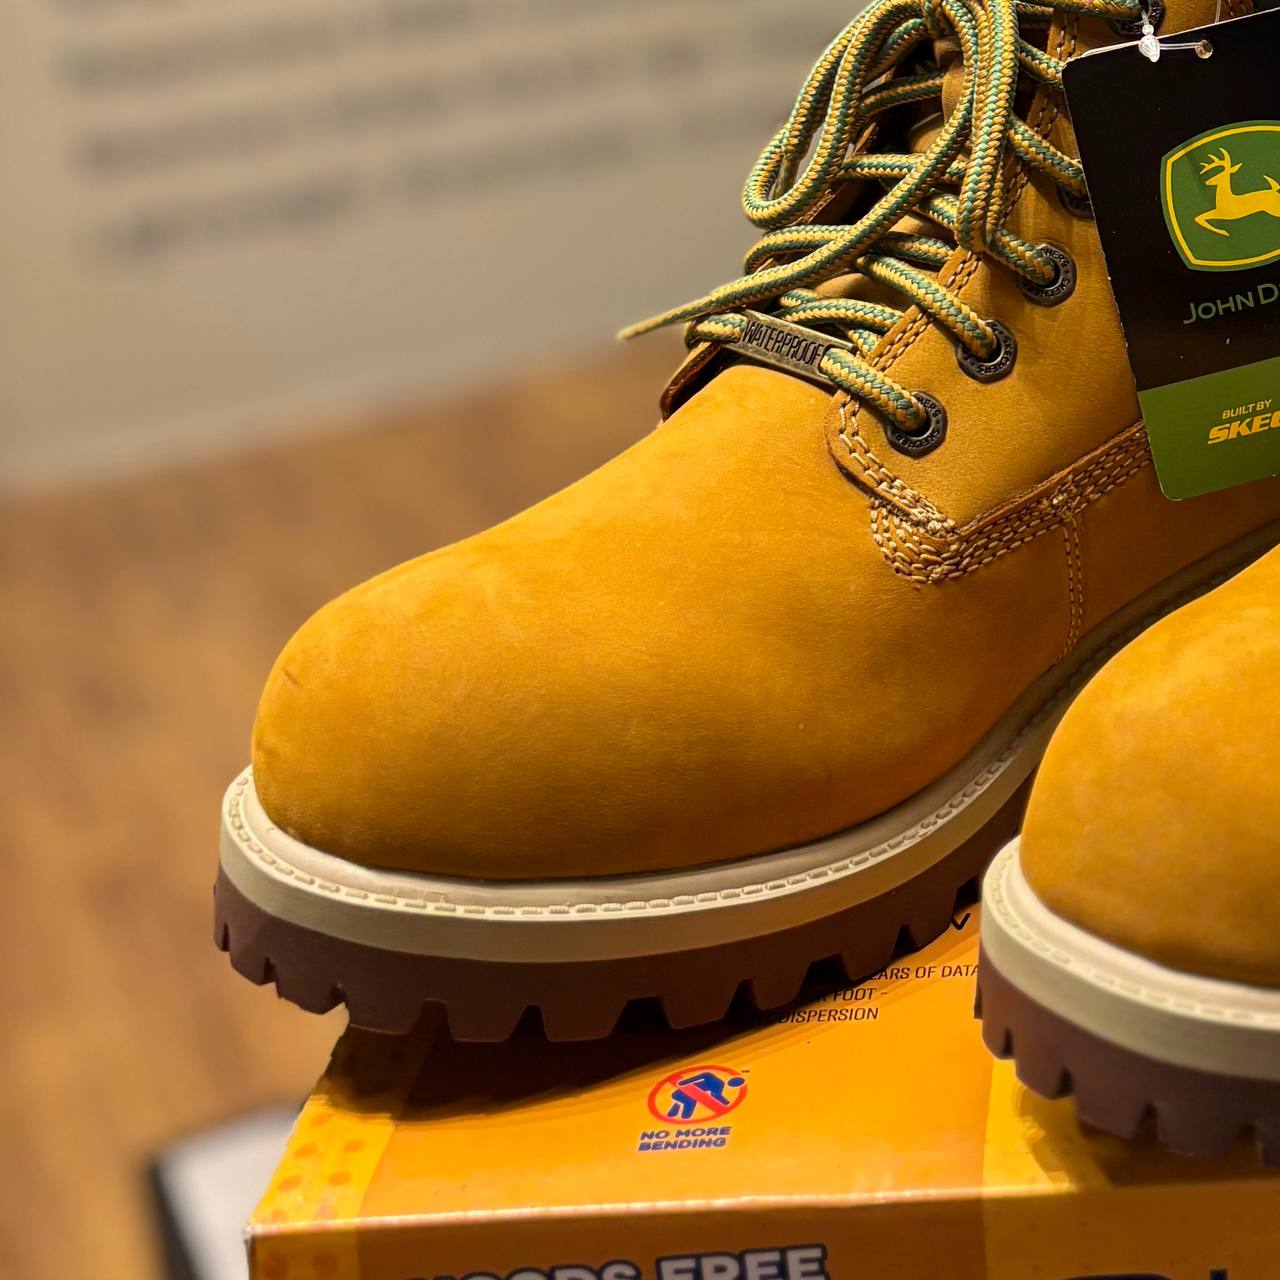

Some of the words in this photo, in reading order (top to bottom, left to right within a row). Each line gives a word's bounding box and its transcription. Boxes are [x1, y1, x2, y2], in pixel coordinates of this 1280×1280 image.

[1183, 291, 1255, 324] JOHN
[742, 320, 823, 366] WATERPROOF
[1222, 403, 1255, 420] BUILT
[1256, 399, 1273, 412] BY
[915, 966, 937, 979] OF
[833, 987, 877, 1002] FOOT
[640, 1130, 670, 1140] NO
[675, 1126, 732, 1138] MORE
[638, 1137, 726, 1151] BENDING
